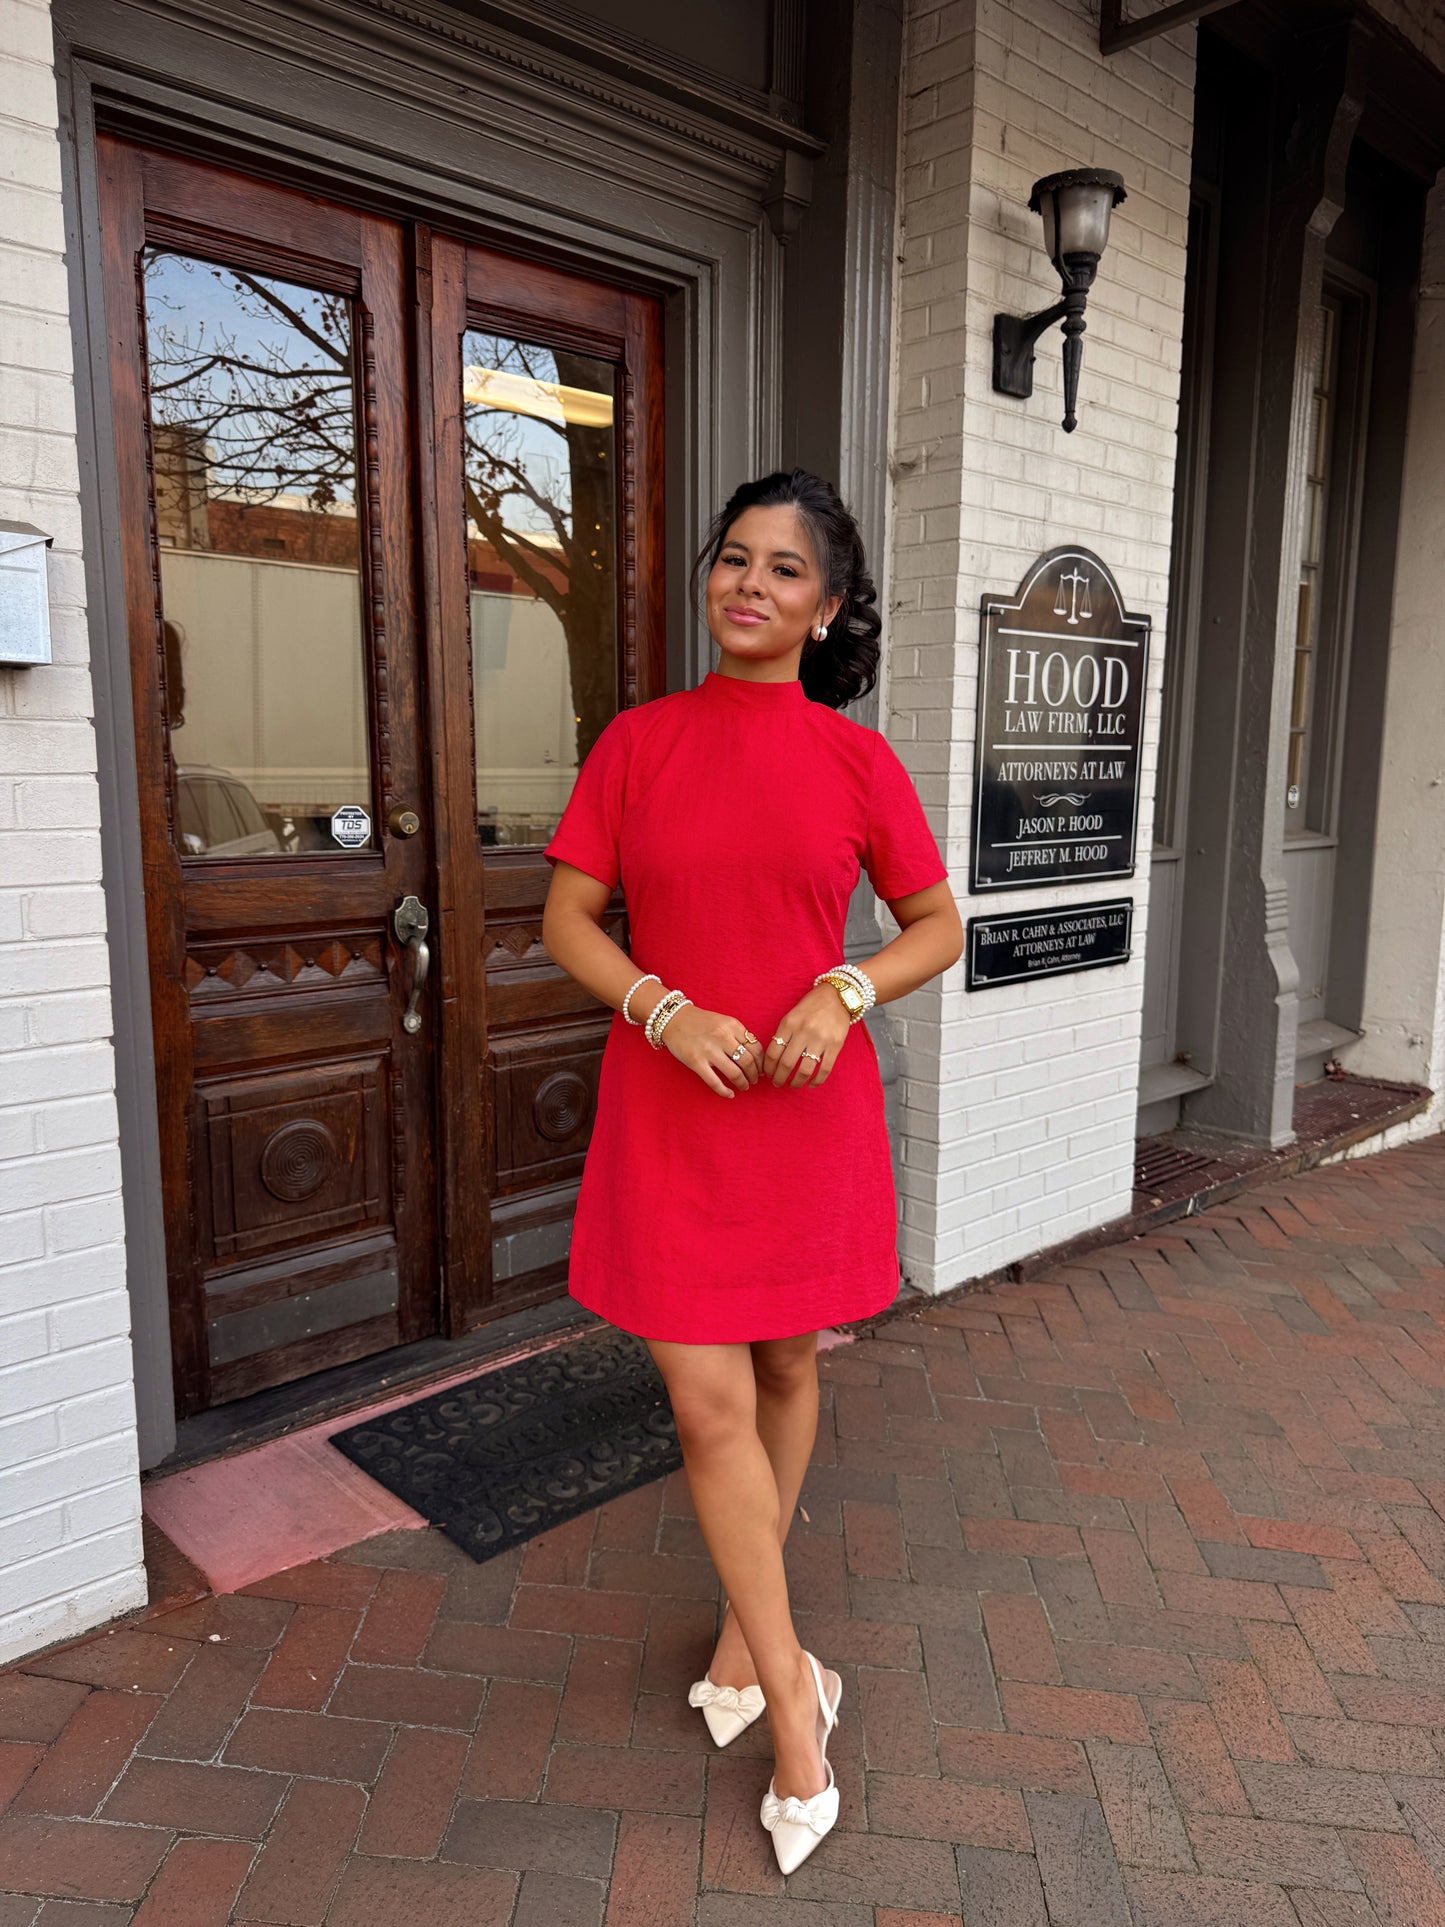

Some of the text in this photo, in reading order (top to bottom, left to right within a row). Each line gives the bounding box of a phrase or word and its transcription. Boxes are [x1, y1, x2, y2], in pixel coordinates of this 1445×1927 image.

[1004, 648, 1129, 708] HOOD
[1004, 710, 1126, 737] LAW FIRM, LLC
[997, 760, 1126, 782] ATTORNEYS AT LAW
[341, 819, 362, 831] TDS
[1016, 815, 1103, 839] JASON P. HOOD
[1006, 845, 1108, 872] JEFFREY M. HOOD
[980, 913, 1124, 946] BRIAN R. CAHN & ASSOCIATES, LLC
[1012, 933, 1096, 957] ATTORNEYS AT LAW
